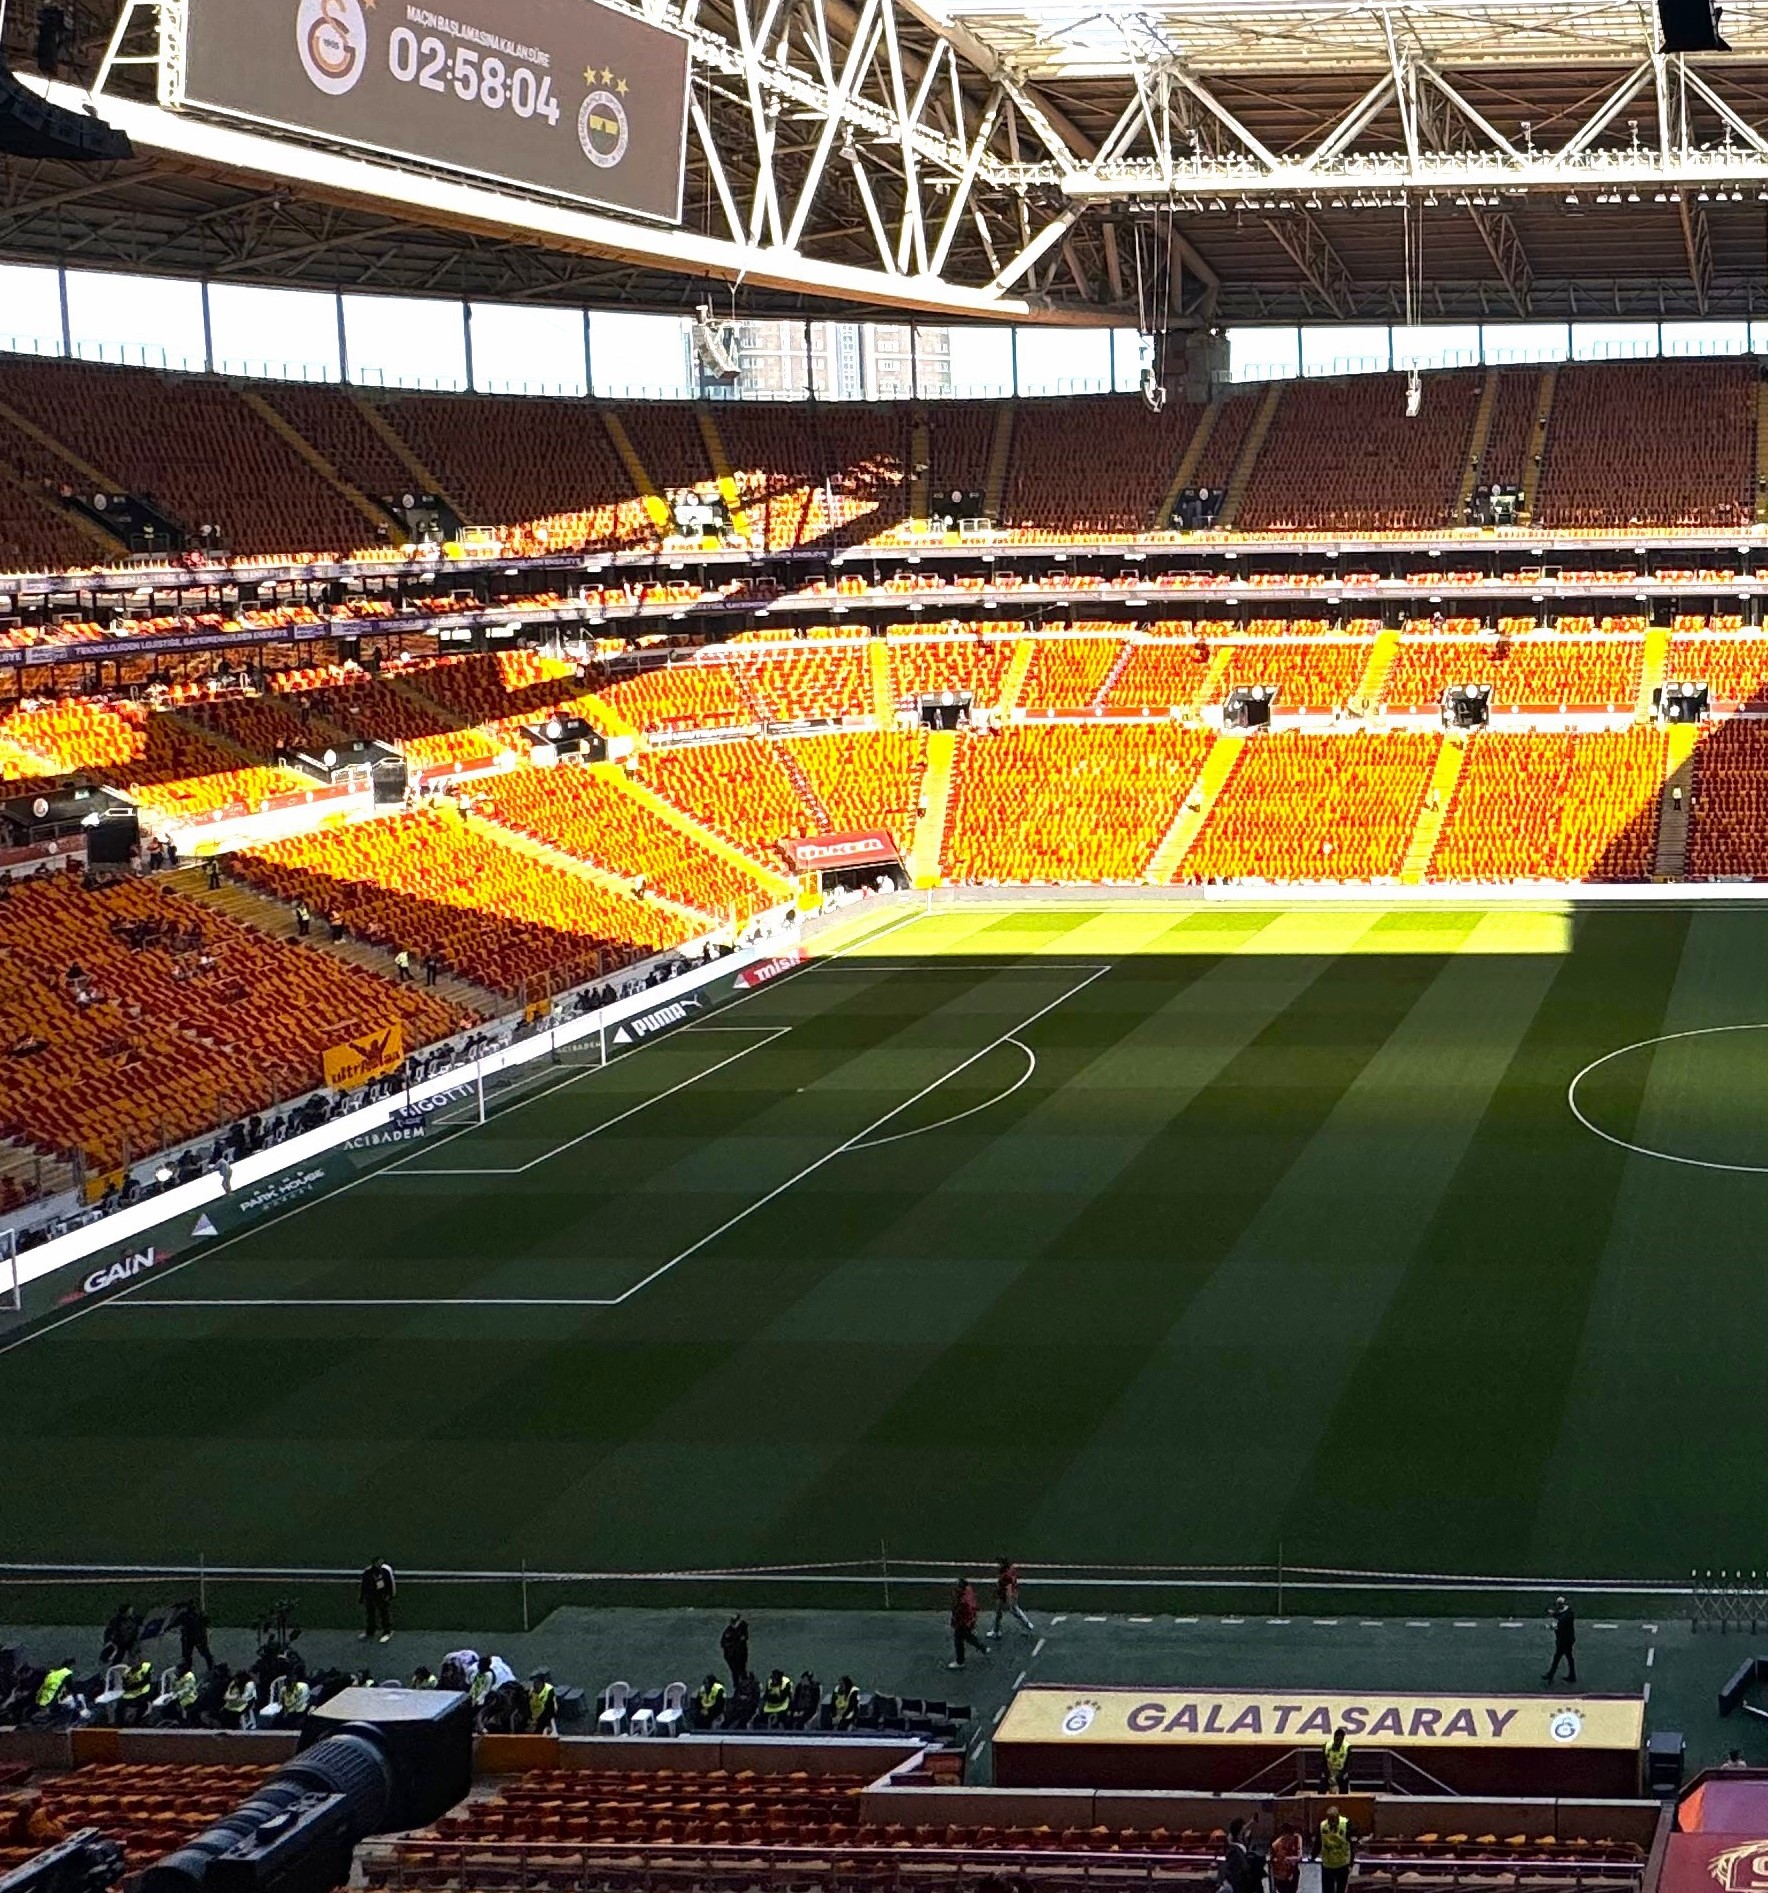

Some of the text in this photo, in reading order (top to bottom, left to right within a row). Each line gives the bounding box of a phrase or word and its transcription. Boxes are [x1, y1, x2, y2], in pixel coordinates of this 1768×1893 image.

[389, 26, 560, 125] 02:58:04
[631, 1003, 687, 1037] PUMA
[344, 1125, 425, 1151] ACIBADEM
[240, 1190, 279, 1212] PARK
[1126, 1703, 1519, 1737] GALATASARAY
